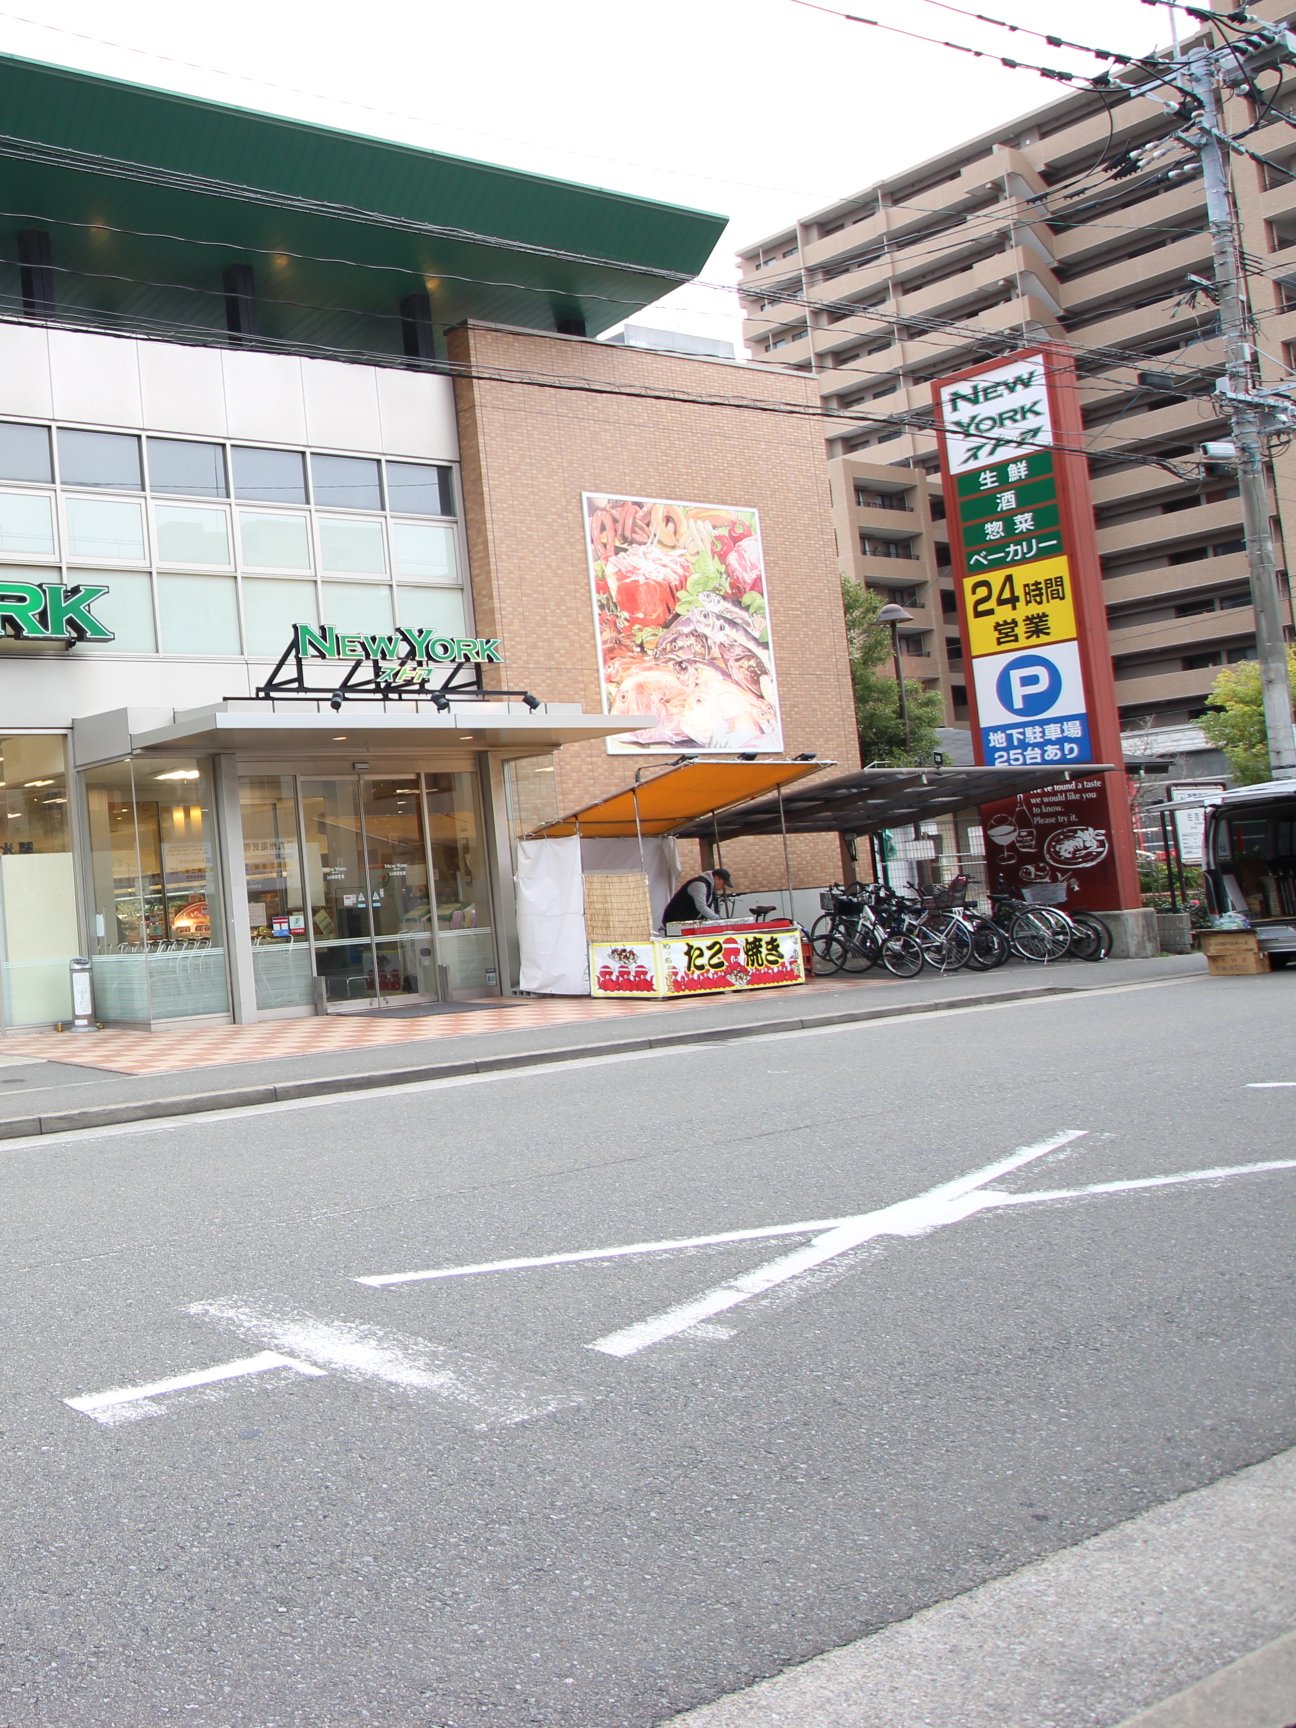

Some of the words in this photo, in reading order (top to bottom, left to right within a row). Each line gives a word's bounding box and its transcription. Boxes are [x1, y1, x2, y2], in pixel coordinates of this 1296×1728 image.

[952, 398, 1045, 440] YORK
[957, 425, 1044, 466] ストア
[979, 460, 1029, 490] 生鮮
[996, 490, 1016, 512] 酒
[984, 512, 1035, 541] 惣菜
[969, 538, 1058, 566] ベーカリー
[971, 573, 1066, 619] 24時間
[993, 611, 1051, 646] 営業
[298, 624, 402, 659] NEW
[400, 627, 504, 663] YORK
[376, 665, 434, 683] ストア
[1009, 665, 1050, 709] P
[987, 720, 1082, 748] 地下駐車場
[993, 742, 1078, 767] 25台あり
[1042, 793, 1065, 802] would
[1067, 792, 1080, 800] like
[1082, 791, 1096, 799] you
[1042, 804, 1064, 813] know.
[1034, 816, 1055, 824] Please
[1058, 815, 1068, 823] try
[1070, 813, 1078, 821] it.
